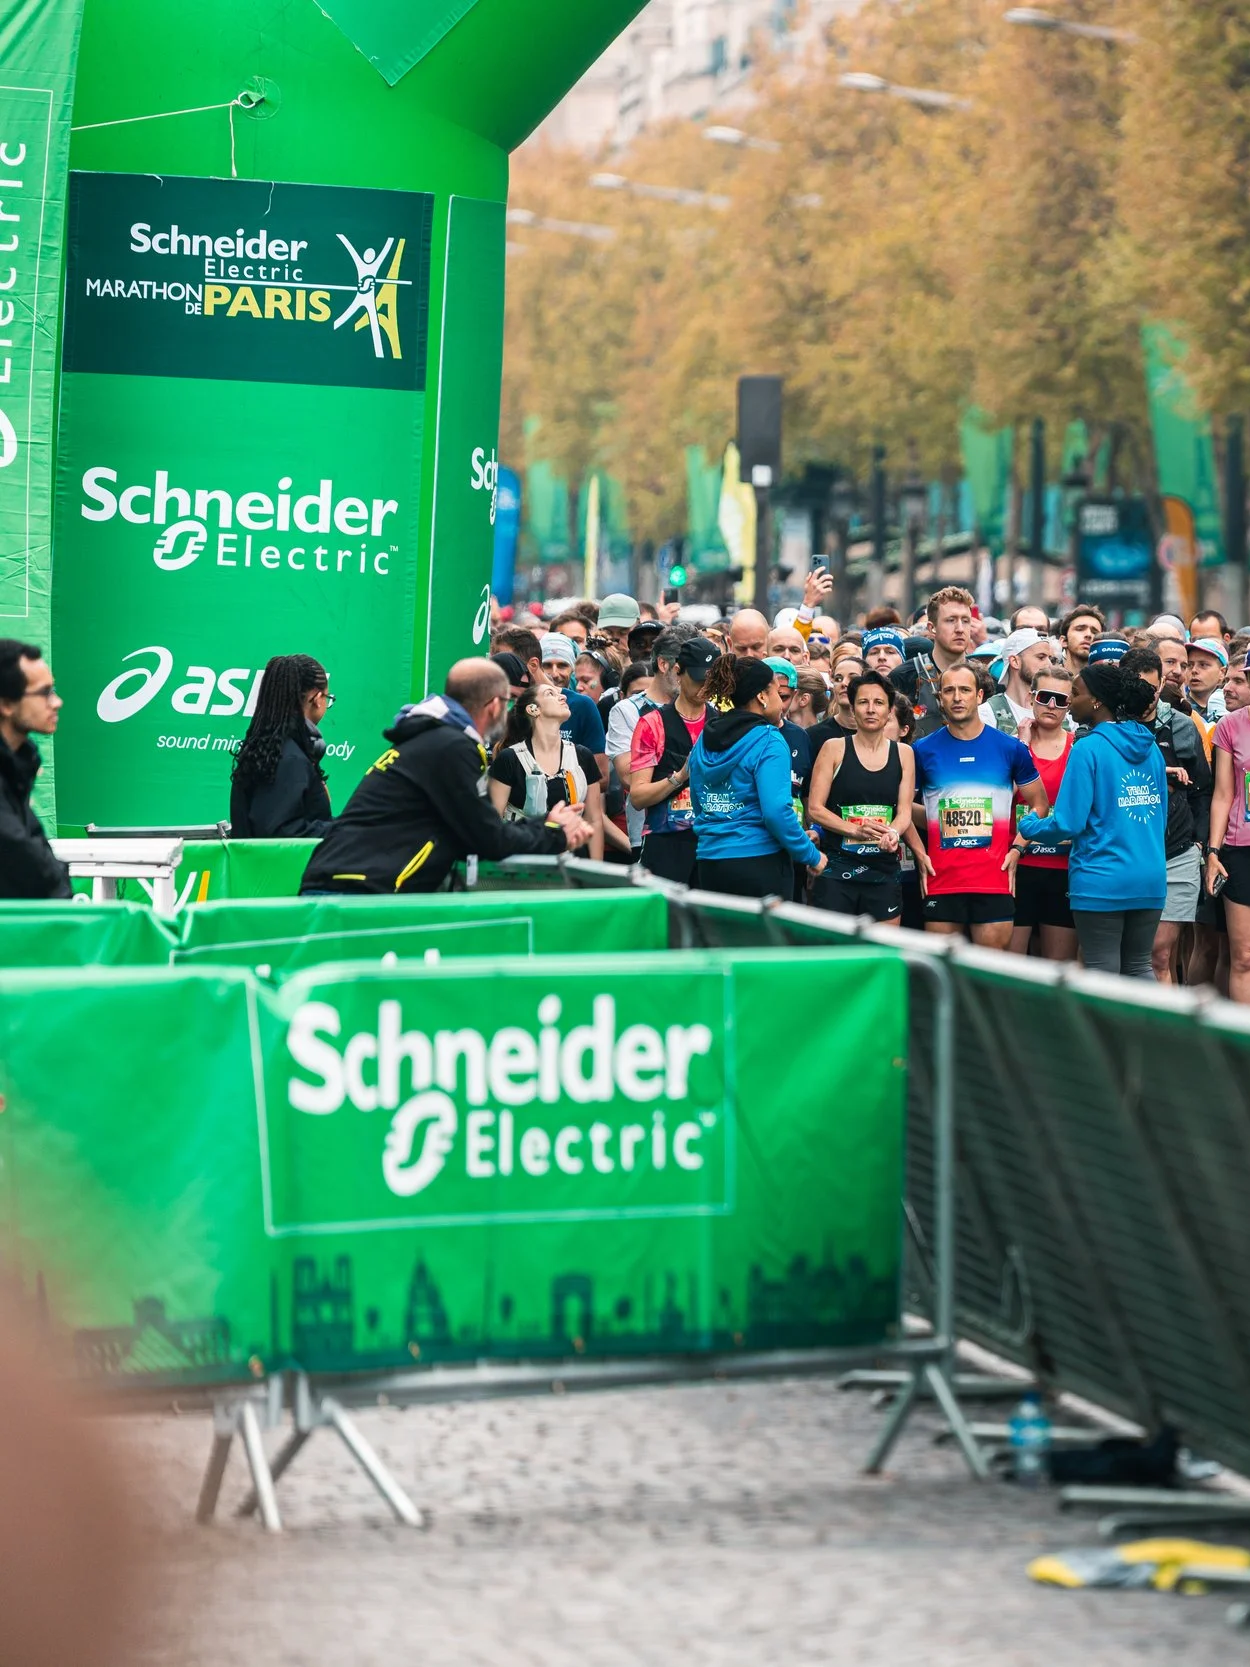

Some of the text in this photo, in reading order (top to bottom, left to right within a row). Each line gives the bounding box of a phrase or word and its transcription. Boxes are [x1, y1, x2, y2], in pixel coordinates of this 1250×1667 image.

[130, 222, 308, 261] Schneider
[205, 258, 303, 281] Electric
[86, 278, 332, 322] MARATHON PARIS
[185, 302, 202, 315] DE
[81, 466, 399, 537] Schneider
[157, 734, 211, 751] sound
[325, 741, 356, 761] ody
[706, 793, 730, 803] TEAM
[1126, 785, 1150, 796] TEAM
[945, 810, 982, 827] 48520
[286, 993, 713, 1115] Schneider
